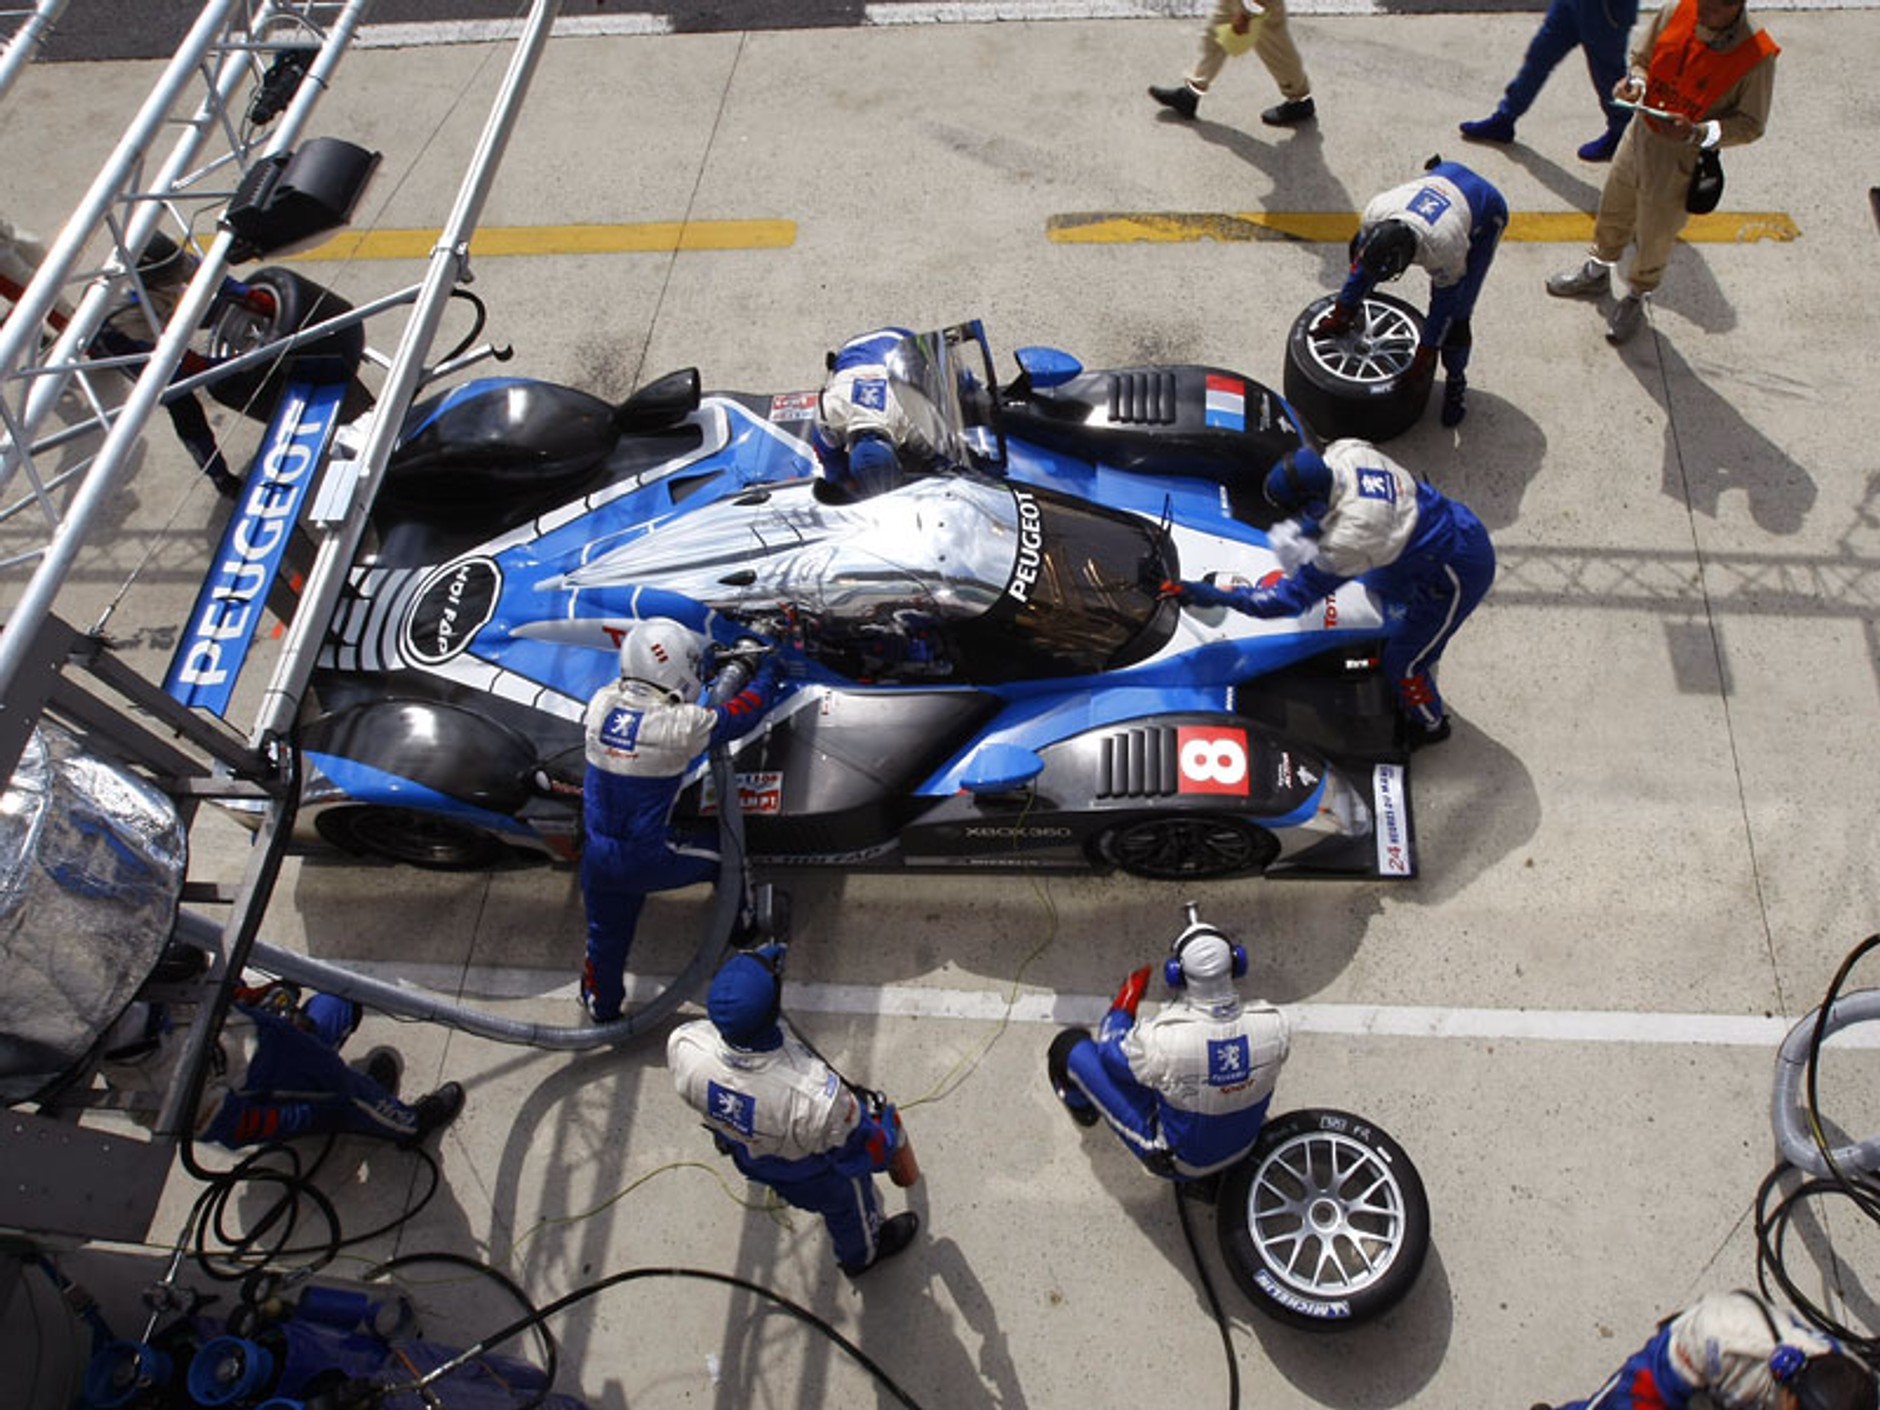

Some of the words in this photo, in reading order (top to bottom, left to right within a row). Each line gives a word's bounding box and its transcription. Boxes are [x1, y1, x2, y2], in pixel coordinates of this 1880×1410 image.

[178, 398, 322, 686] PEUGEOT
[1008, 488, 1042, 603] PEUGEOT
[1180, 737, 1248, 785] 8
[1387, 846, 1405, 872] 24
[1255, 1270, 1330, 1317] MICHELIN
